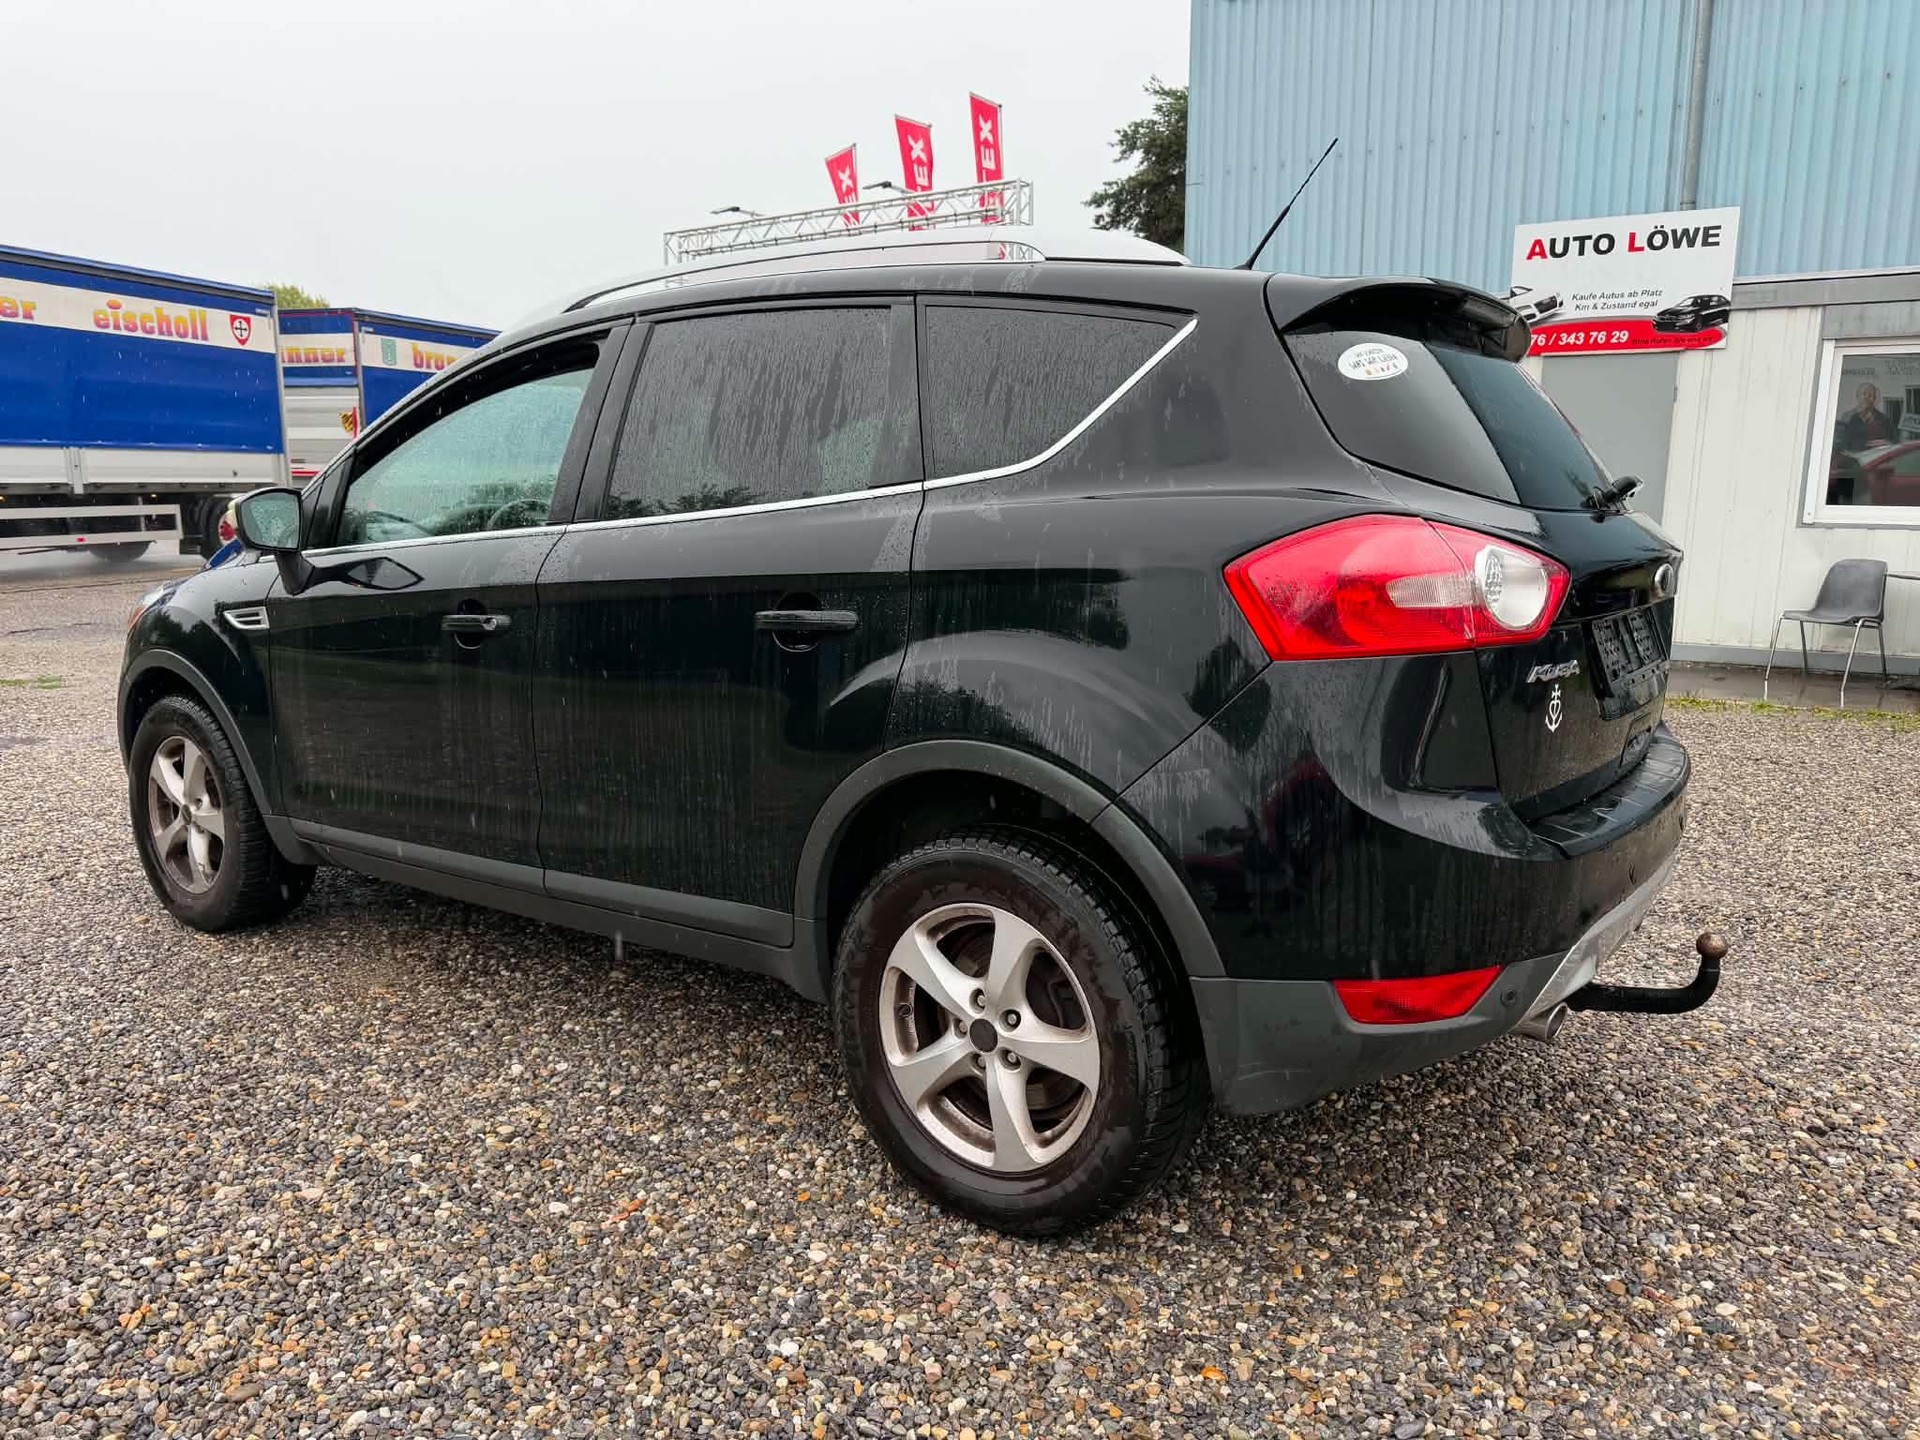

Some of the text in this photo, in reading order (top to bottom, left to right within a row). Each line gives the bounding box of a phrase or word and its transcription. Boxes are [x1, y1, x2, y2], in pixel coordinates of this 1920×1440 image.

[1526, 225, 1722, 260] AUTO LÖWE
[1571, 292, 1598, 301] Kaufe
[1627, 290, 1639, 298] ab
[1640, 289, 1664, 297] Platz
[1600, 300, 1637, 310] Zustand
[1639, 300, 1659, 309] egal
[93, 299, 209, 341] eischoll
[1558, 331, 1586, 345] 343
[1589, 331, 1607, 344] 76
[1610, 330, 1630, 343] 29
